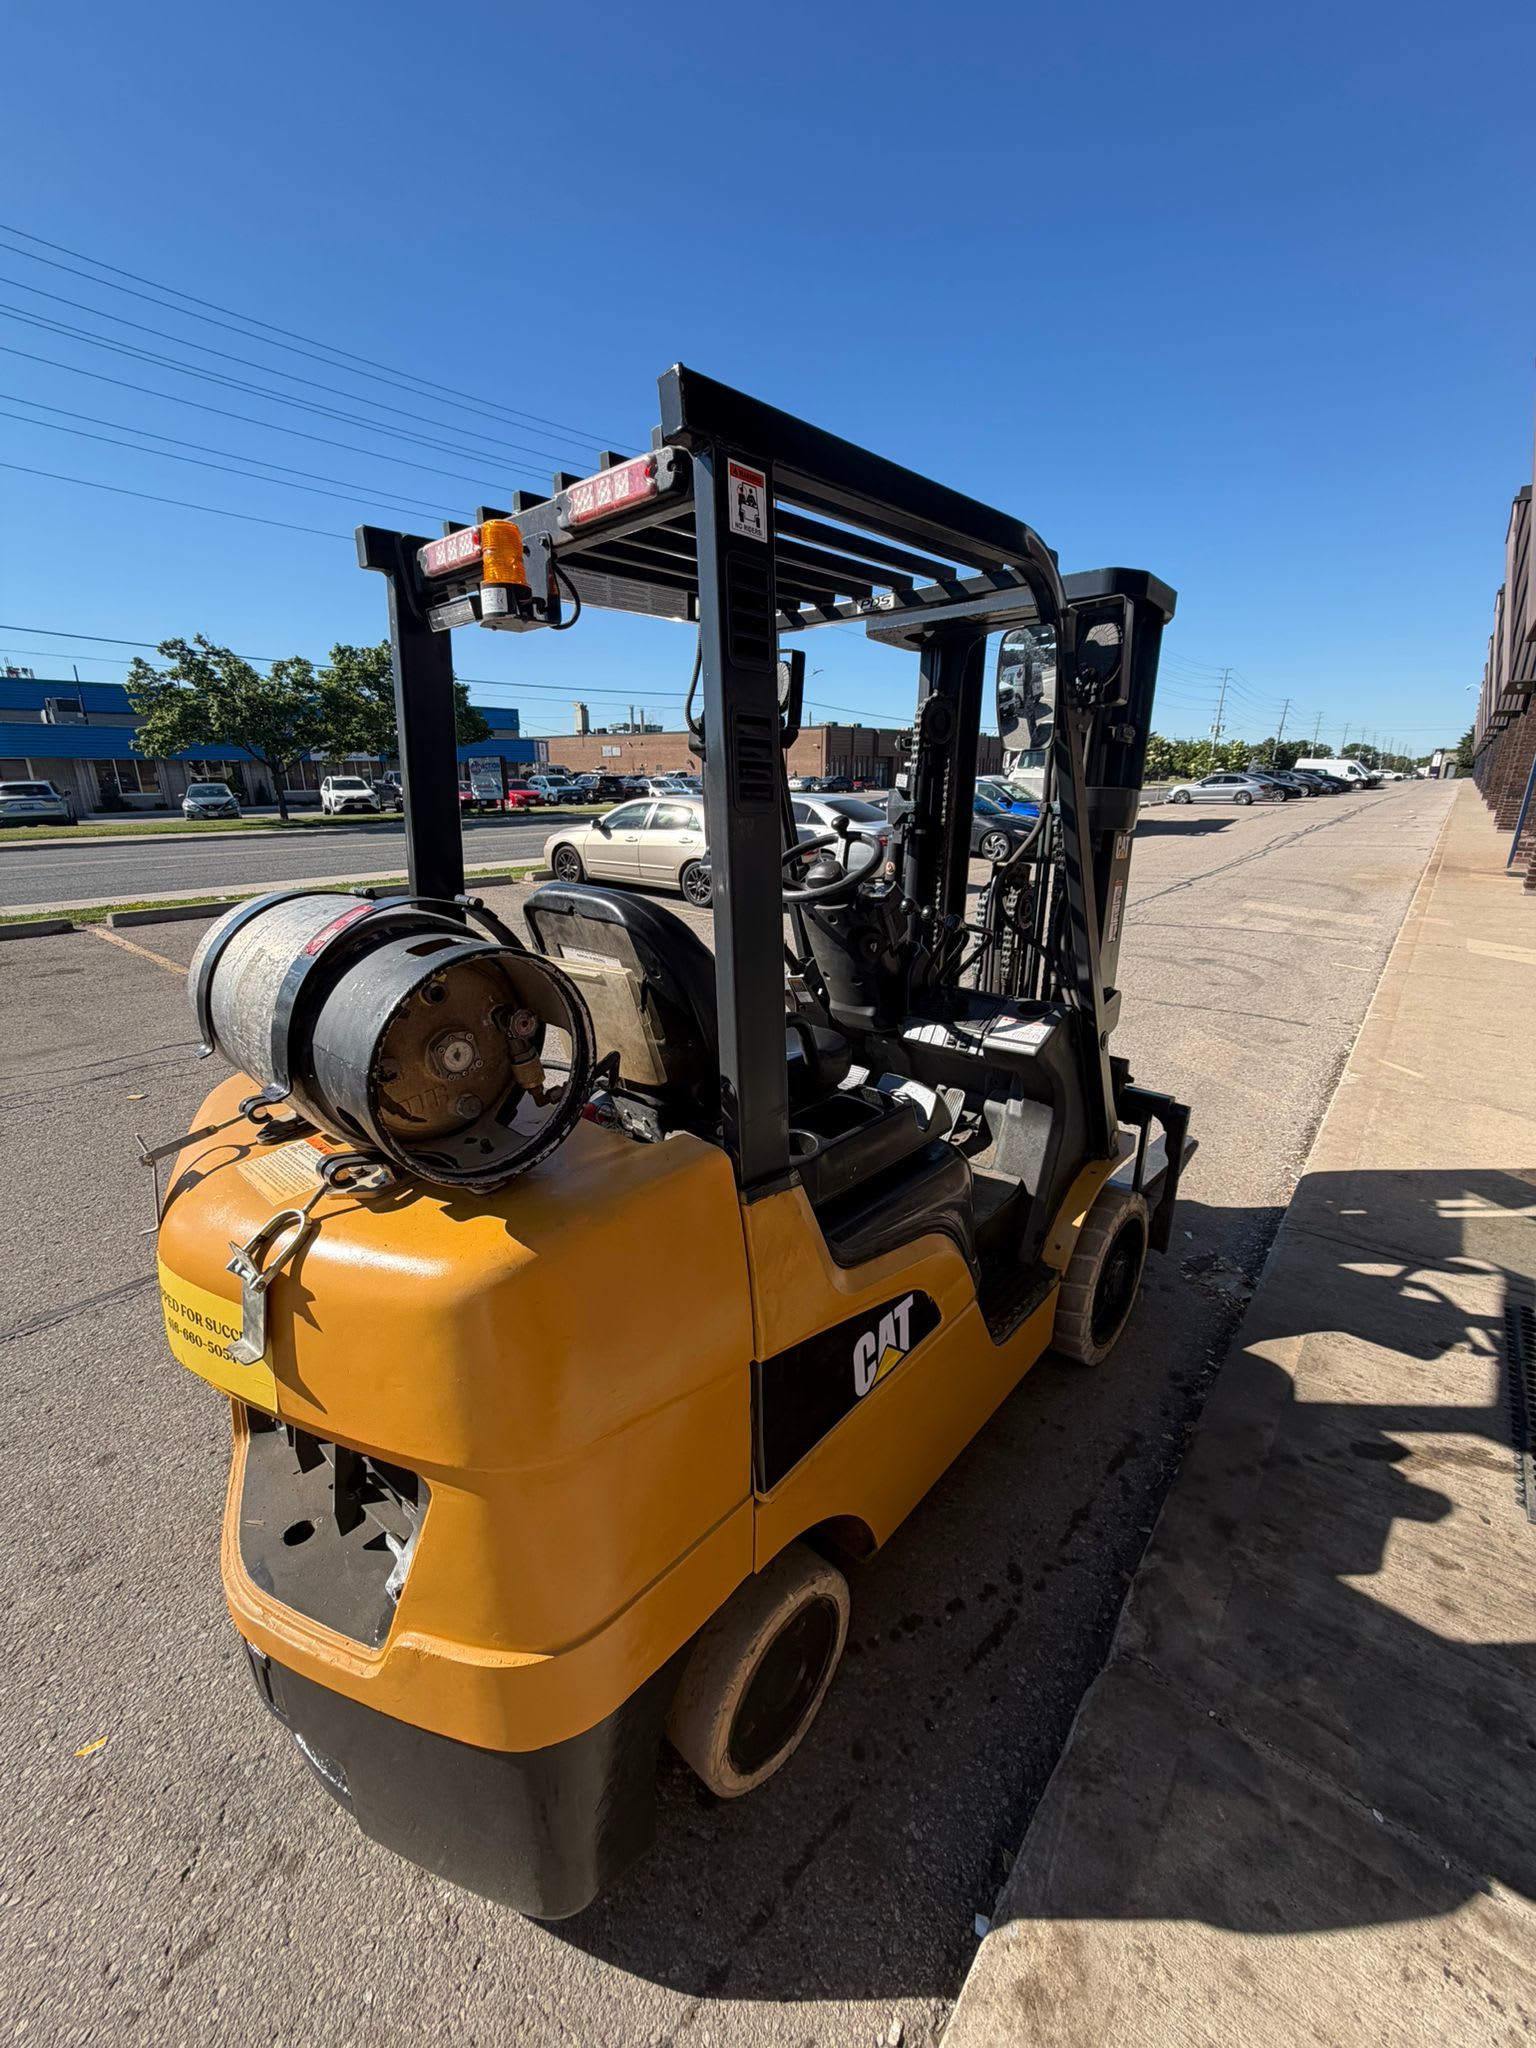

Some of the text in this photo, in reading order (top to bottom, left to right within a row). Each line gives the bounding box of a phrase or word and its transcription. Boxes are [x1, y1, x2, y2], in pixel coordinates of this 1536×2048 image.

[735, 521, 762, 537] NO RIDERS
[860, 595, 892, 609] PDS
[1116, 836, 1131, 859] CAT
[181, 1303, 203, 1328] FOR
[853, 1293, 914, 1397] CAT
